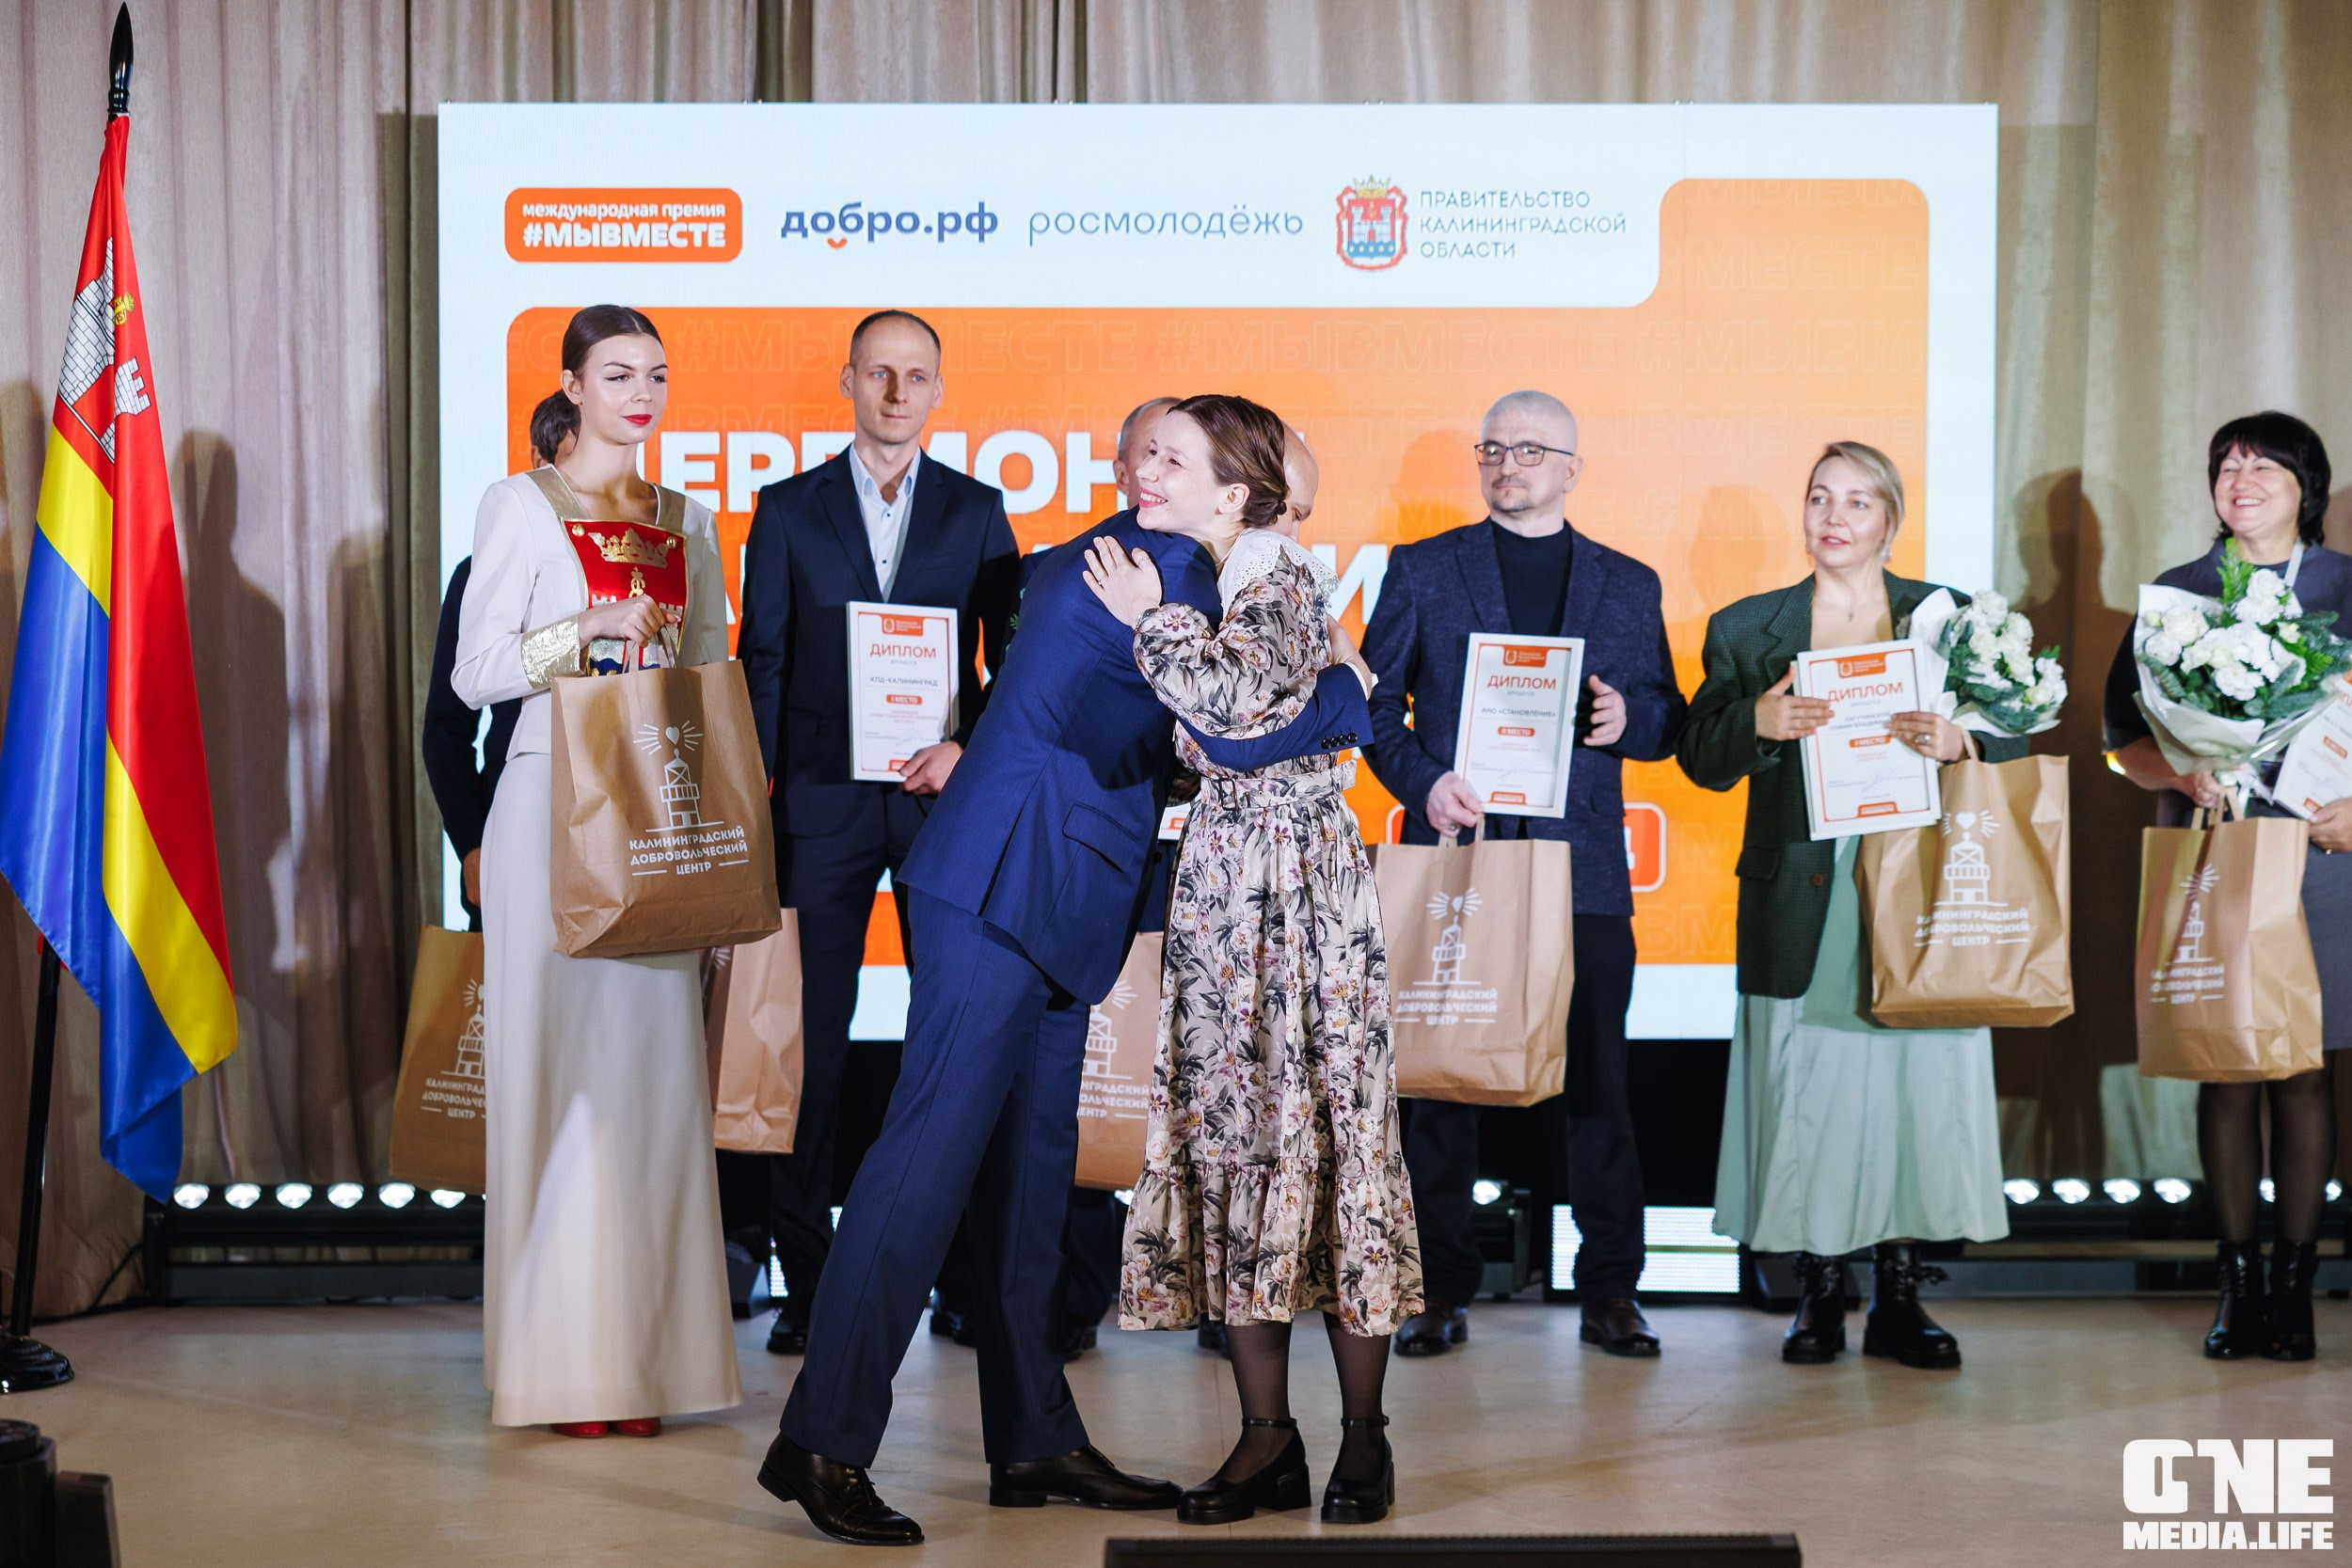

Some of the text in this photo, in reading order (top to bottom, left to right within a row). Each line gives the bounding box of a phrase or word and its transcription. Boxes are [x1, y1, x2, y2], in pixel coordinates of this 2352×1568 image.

[1420, 191, 1591, 208] ПРАВИТЕЛЬСТВО
[522, 203, 725, 221] международная премия
[780, 201, 999, 243] добро.рф
[1028, 205, 1304, 246] росмолодёжь
[1420, 213, 1627, 235] КАЛИНИНГРАДСКОЙ
[522, 222, 726, 247] #МЫВМЕСТЕ
[1420, 242, 1516, 259] ОБЛАСТИ
[869, 643, 936, 659] ДИПЛОМ
[1486, 674, 1557, 690] ДИПЛОМ
[1827, 682, 1903, 703] ДИПЛОМ
[1498, 708, 1556, 718] «СТАНОВЛЕНИЕ»
[1507, 728, 1532, 736] МЕСТО
[628, 825, 745, 850] КАЛИНИНГРАДСКИЙ
[630, 840, 748, 865] ДОБРОВОЛЬЧЕСКИЙ
[675, 862, 711, 875] ЦЕНТР
[1952, 935, 1991, 946] ЦЕНТР
[447, 1107, 476, 1119] ЦЕНТР
[1078, 1107, 1107, 1119] ЕНТР
